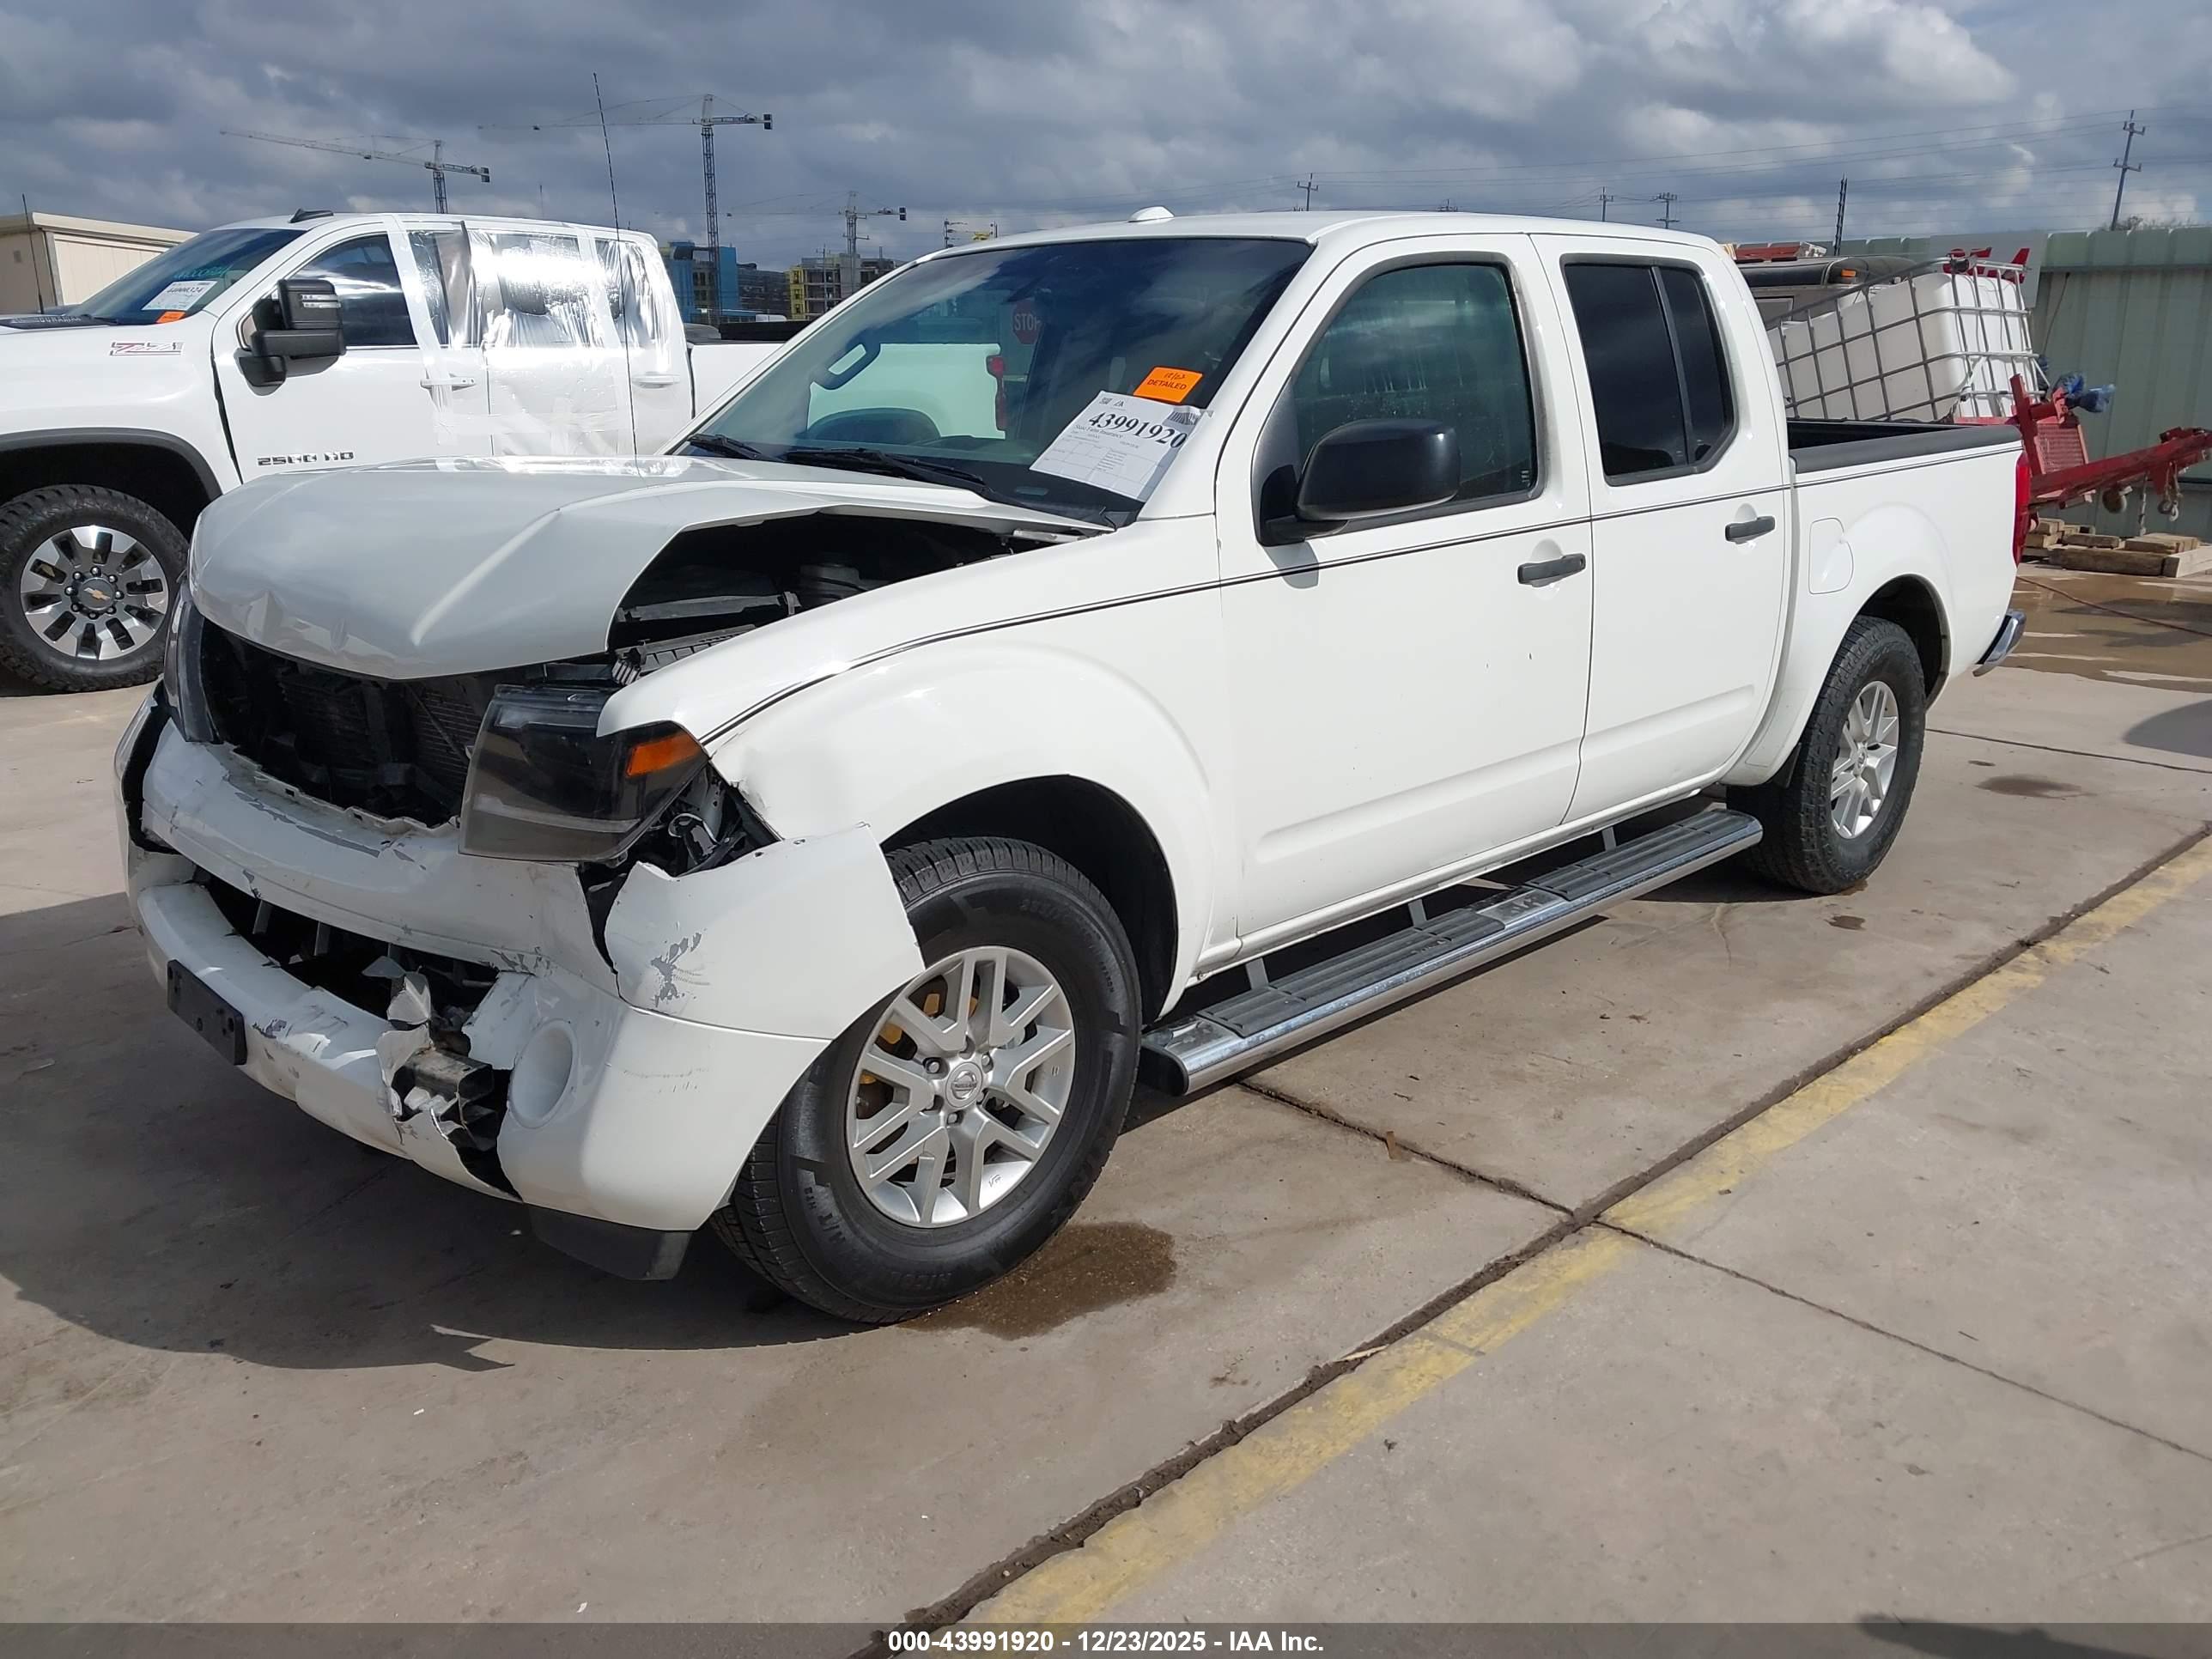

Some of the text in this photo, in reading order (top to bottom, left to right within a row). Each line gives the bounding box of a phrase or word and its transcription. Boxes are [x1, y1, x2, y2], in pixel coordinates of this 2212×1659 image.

[1147, 380, 1187, 390] DETAILED
[1089, 412, 1188, 448] 43991920
[257, 452, 354, 465] 2500 HD
